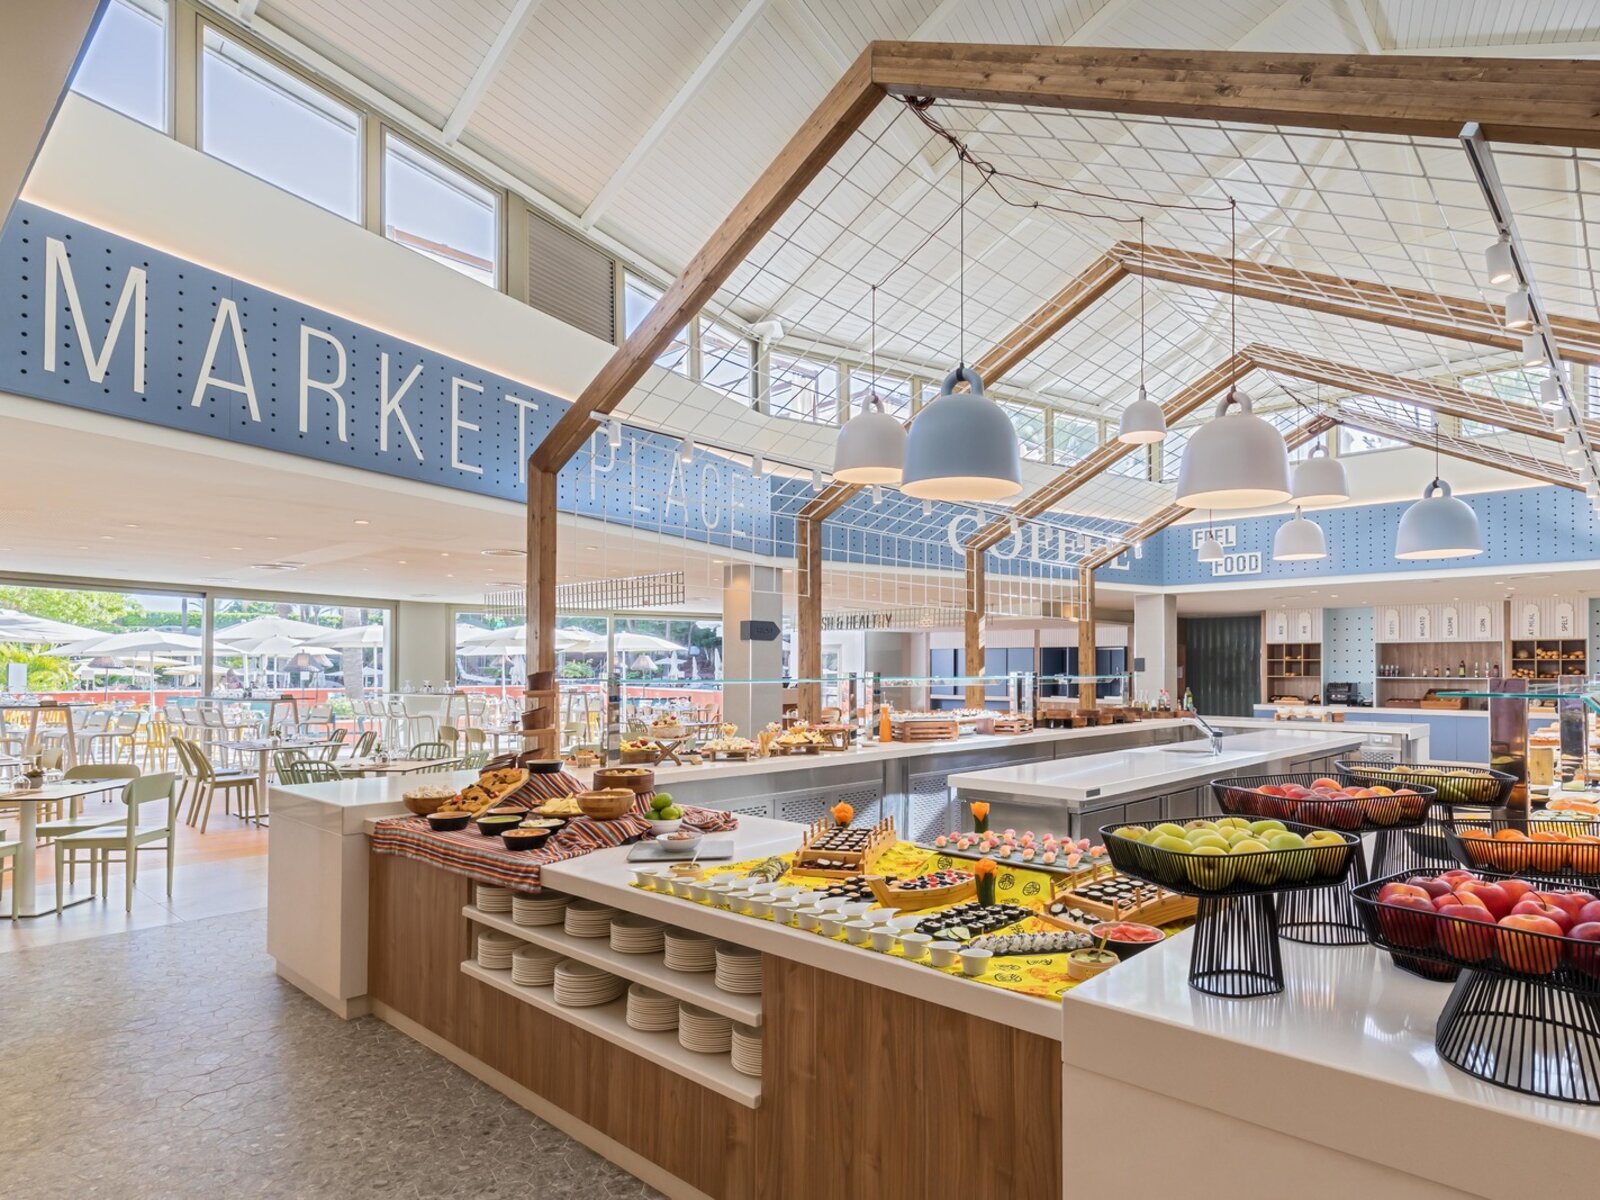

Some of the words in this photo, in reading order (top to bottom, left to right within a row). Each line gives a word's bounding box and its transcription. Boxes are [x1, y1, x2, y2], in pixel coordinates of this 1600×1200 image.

[44, 236, 539, 483] MARKET
[590, 426, 746, 537] PLACE
[1214, 554, 1259, 574] FOOD
[836, 615, 843, 630] &
[846, 613, 892, 630] HEALTHY
